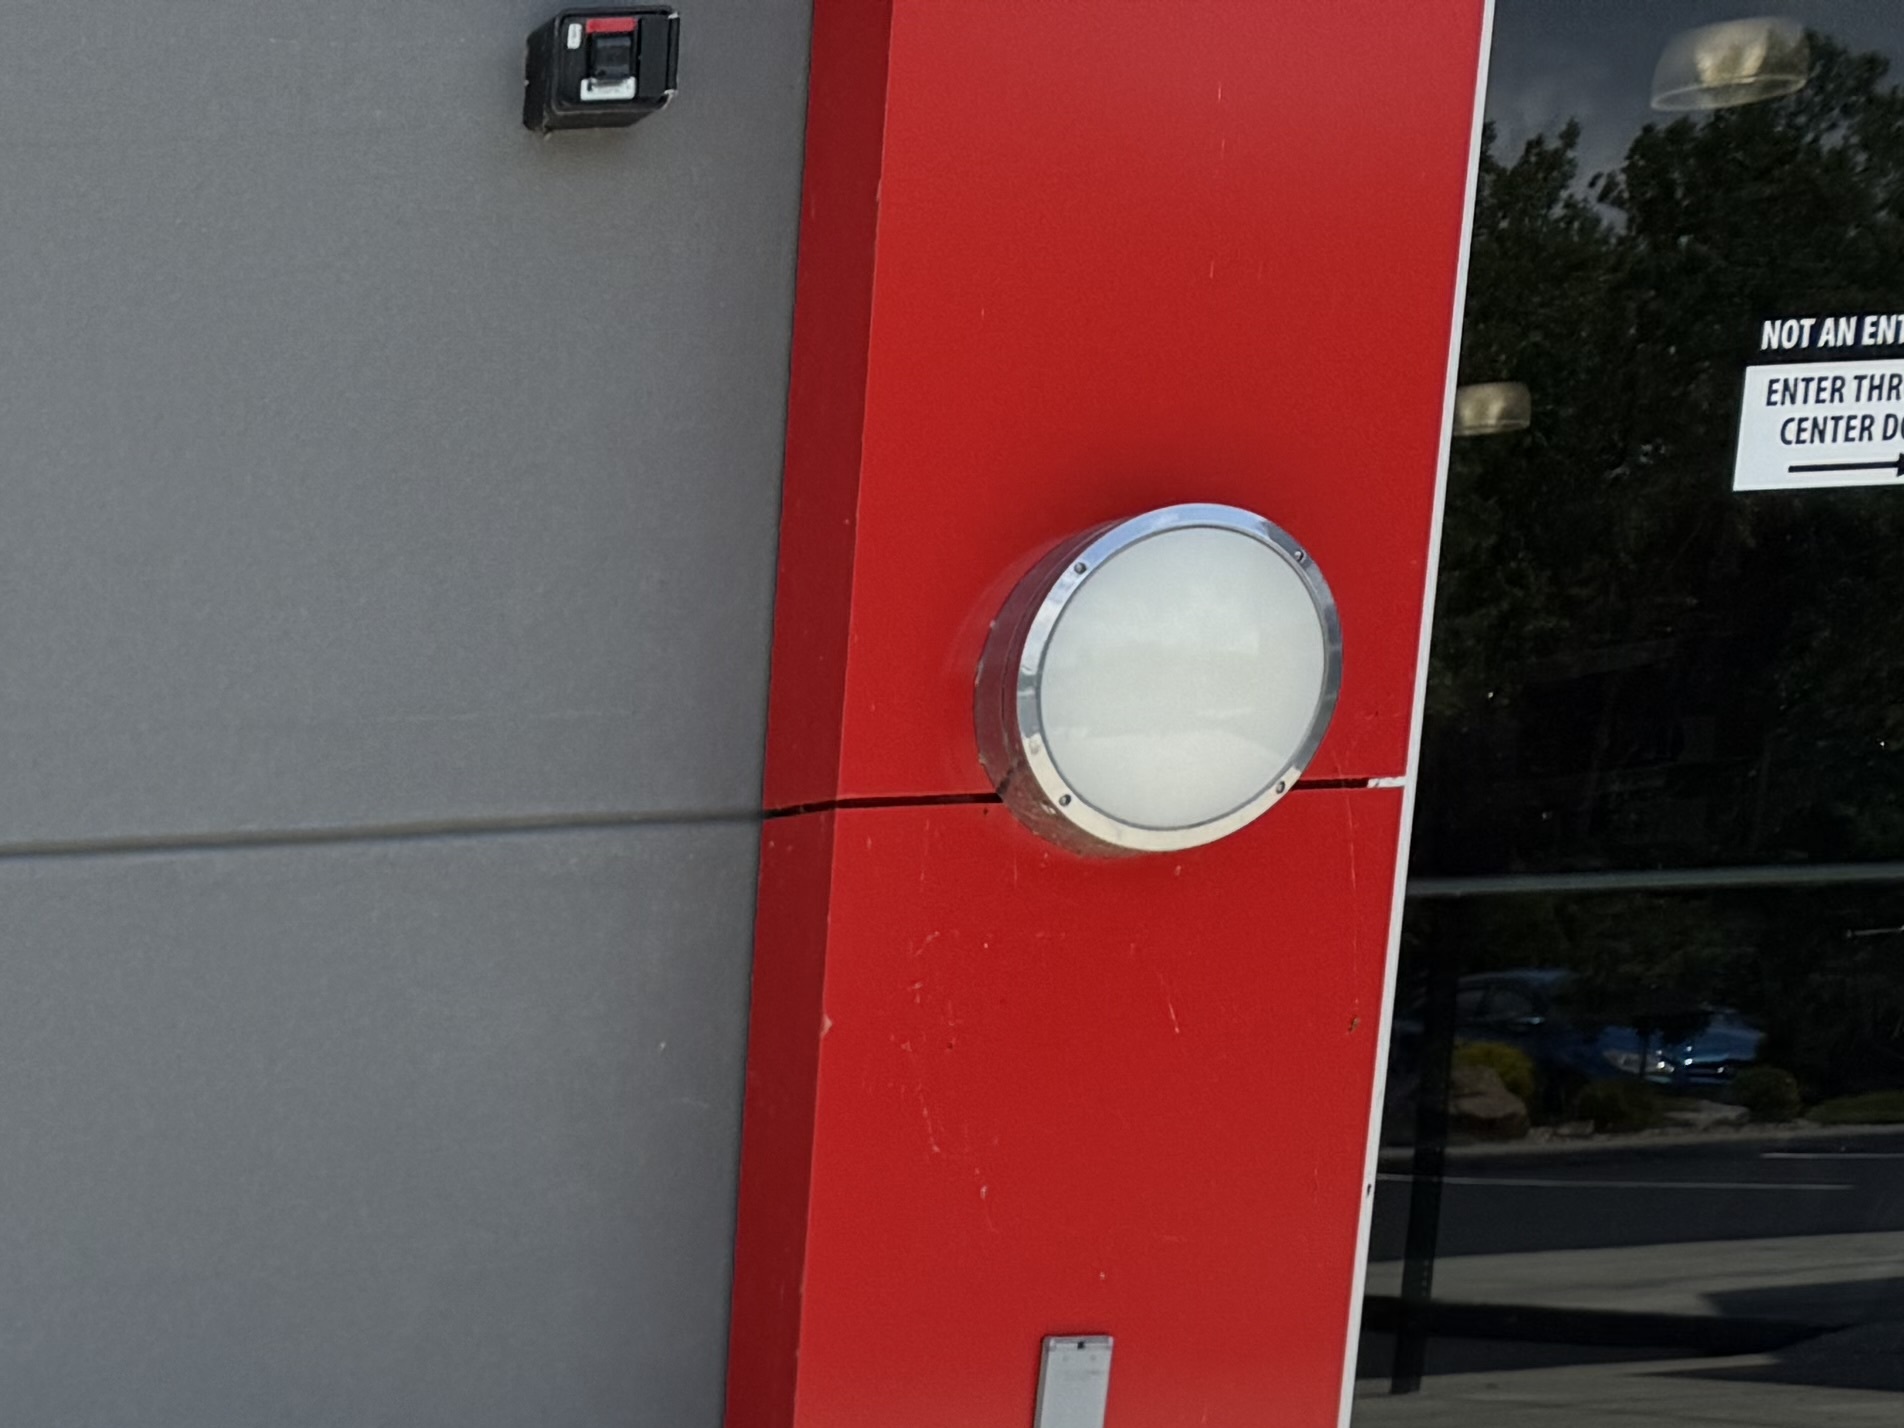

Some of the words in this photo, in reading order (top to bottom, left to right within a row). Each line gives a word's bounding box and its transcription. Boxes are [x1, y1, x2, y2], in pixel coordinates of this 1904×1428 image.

[1761, 318, 1816, 350] NOT
[1817, 316, 1858, 348] AN
[1766, 375, 1846, 406] ENTER
[1853, 373, 1903, 402] THR
[1780, 414, 1875, 445] CENTER
[1882, 412, 1904, 441] D
